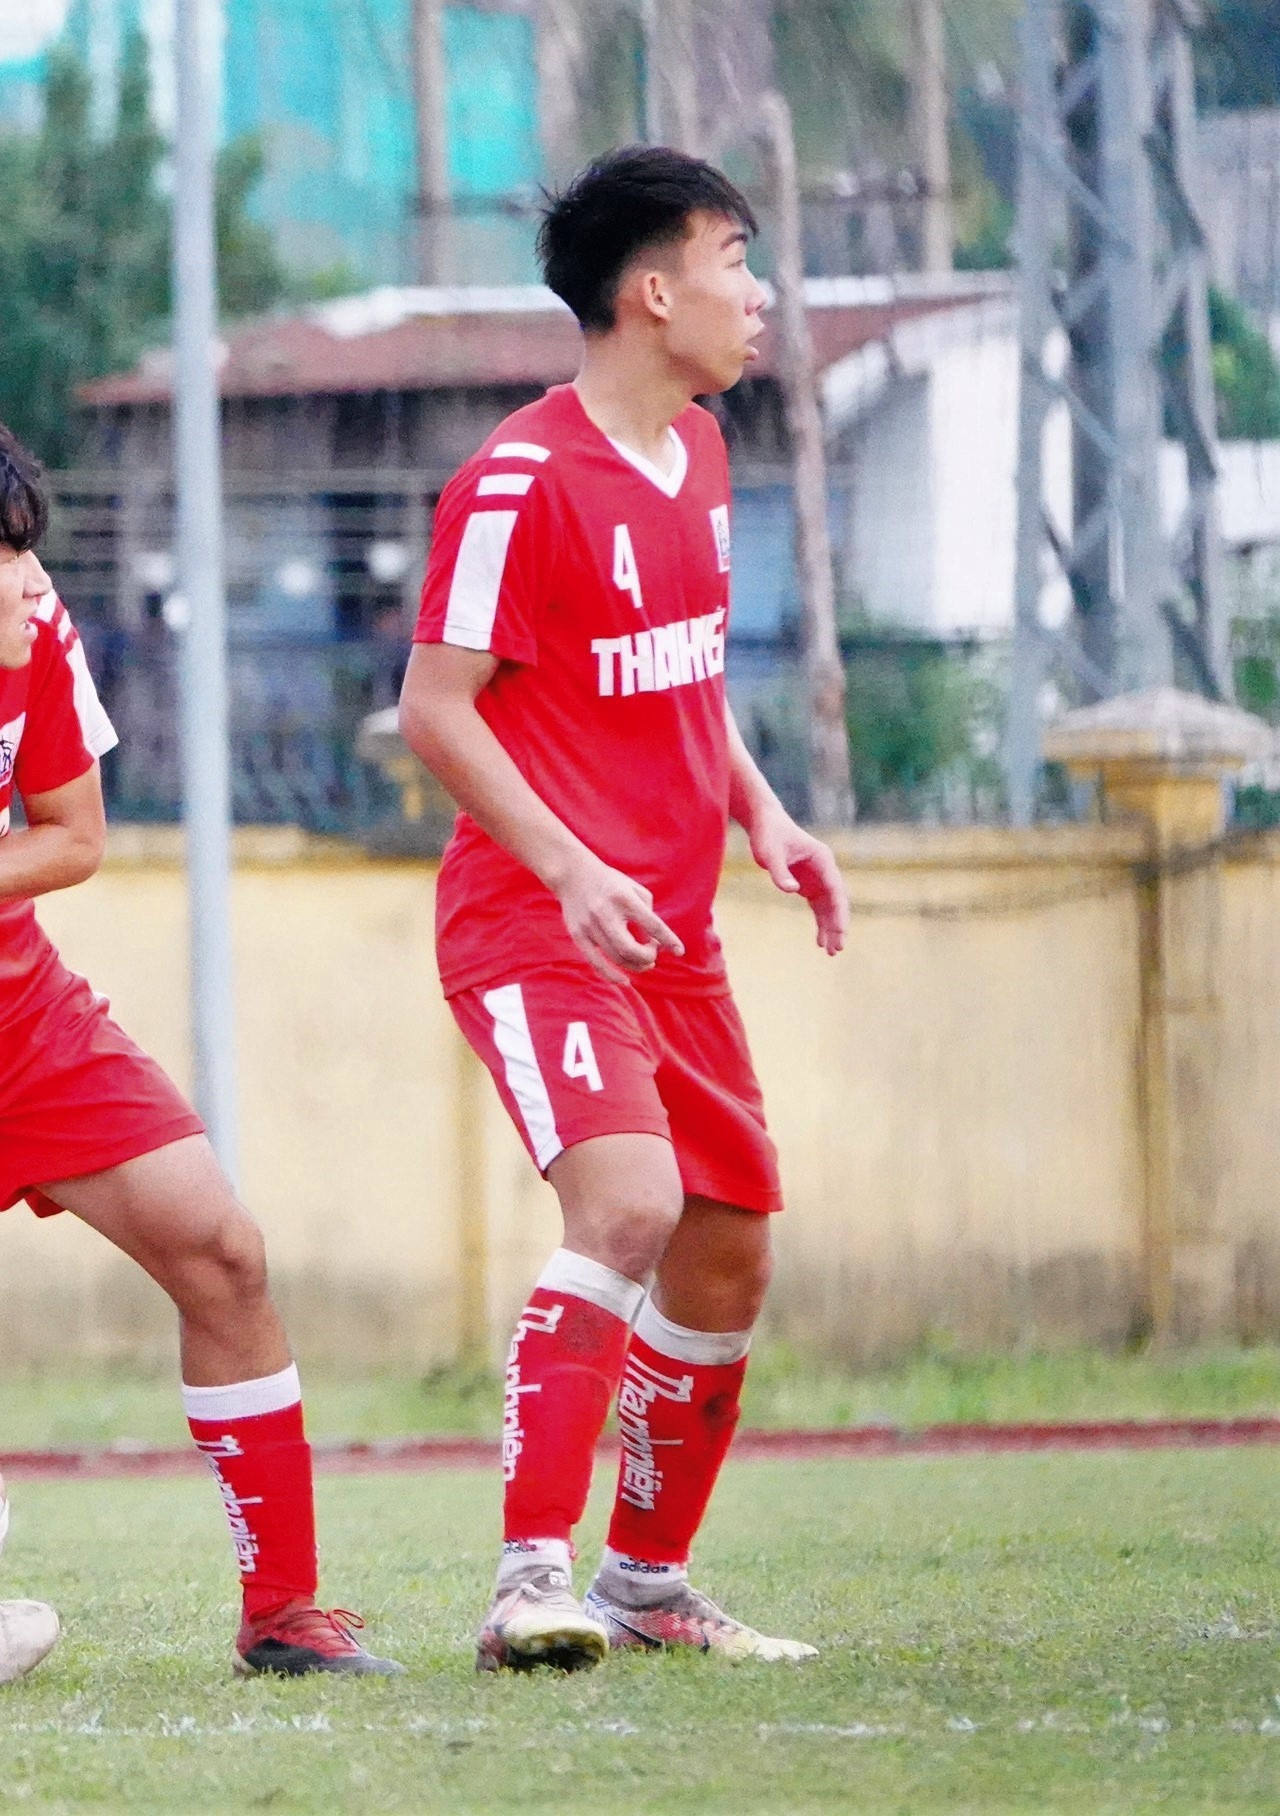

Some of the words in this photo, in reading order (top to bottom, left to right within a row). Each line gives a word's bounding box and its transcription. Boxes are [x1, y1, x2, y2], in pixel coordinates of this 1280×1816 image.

[613, 524, 643, 609] 4
[562, 1021, 604, 1091] 4
[619, 1561, 670, 1574] adidas
